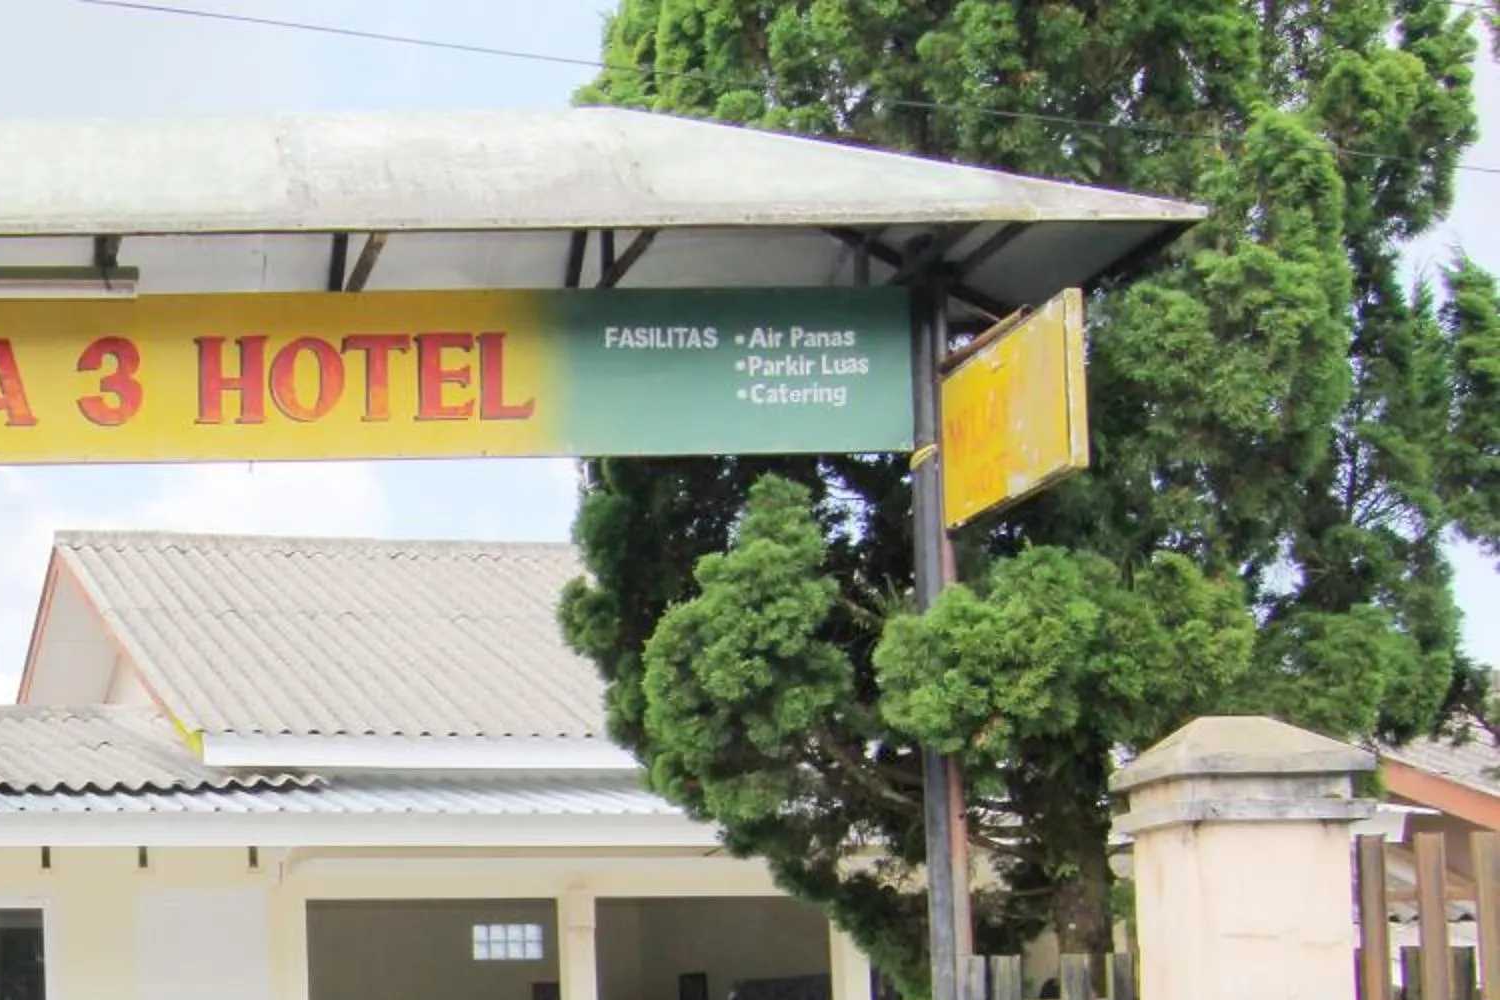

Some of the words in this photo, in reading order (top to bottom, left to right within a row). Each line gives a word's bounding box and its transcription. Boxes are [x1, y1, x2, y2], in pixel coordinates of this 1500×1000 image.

[604, 327, 718, 348] FASILITAS
[749, 327, 782, 348] Air
[790, 326, 855, 347] Panas
[749, 355, 816, 376] Parkir
[821, 354, 869, 375] Luas
[76, 336, 143, 425] 3
[194, 331, 535, 424] HOTEL
[750, 383, 847, 407] Catering
